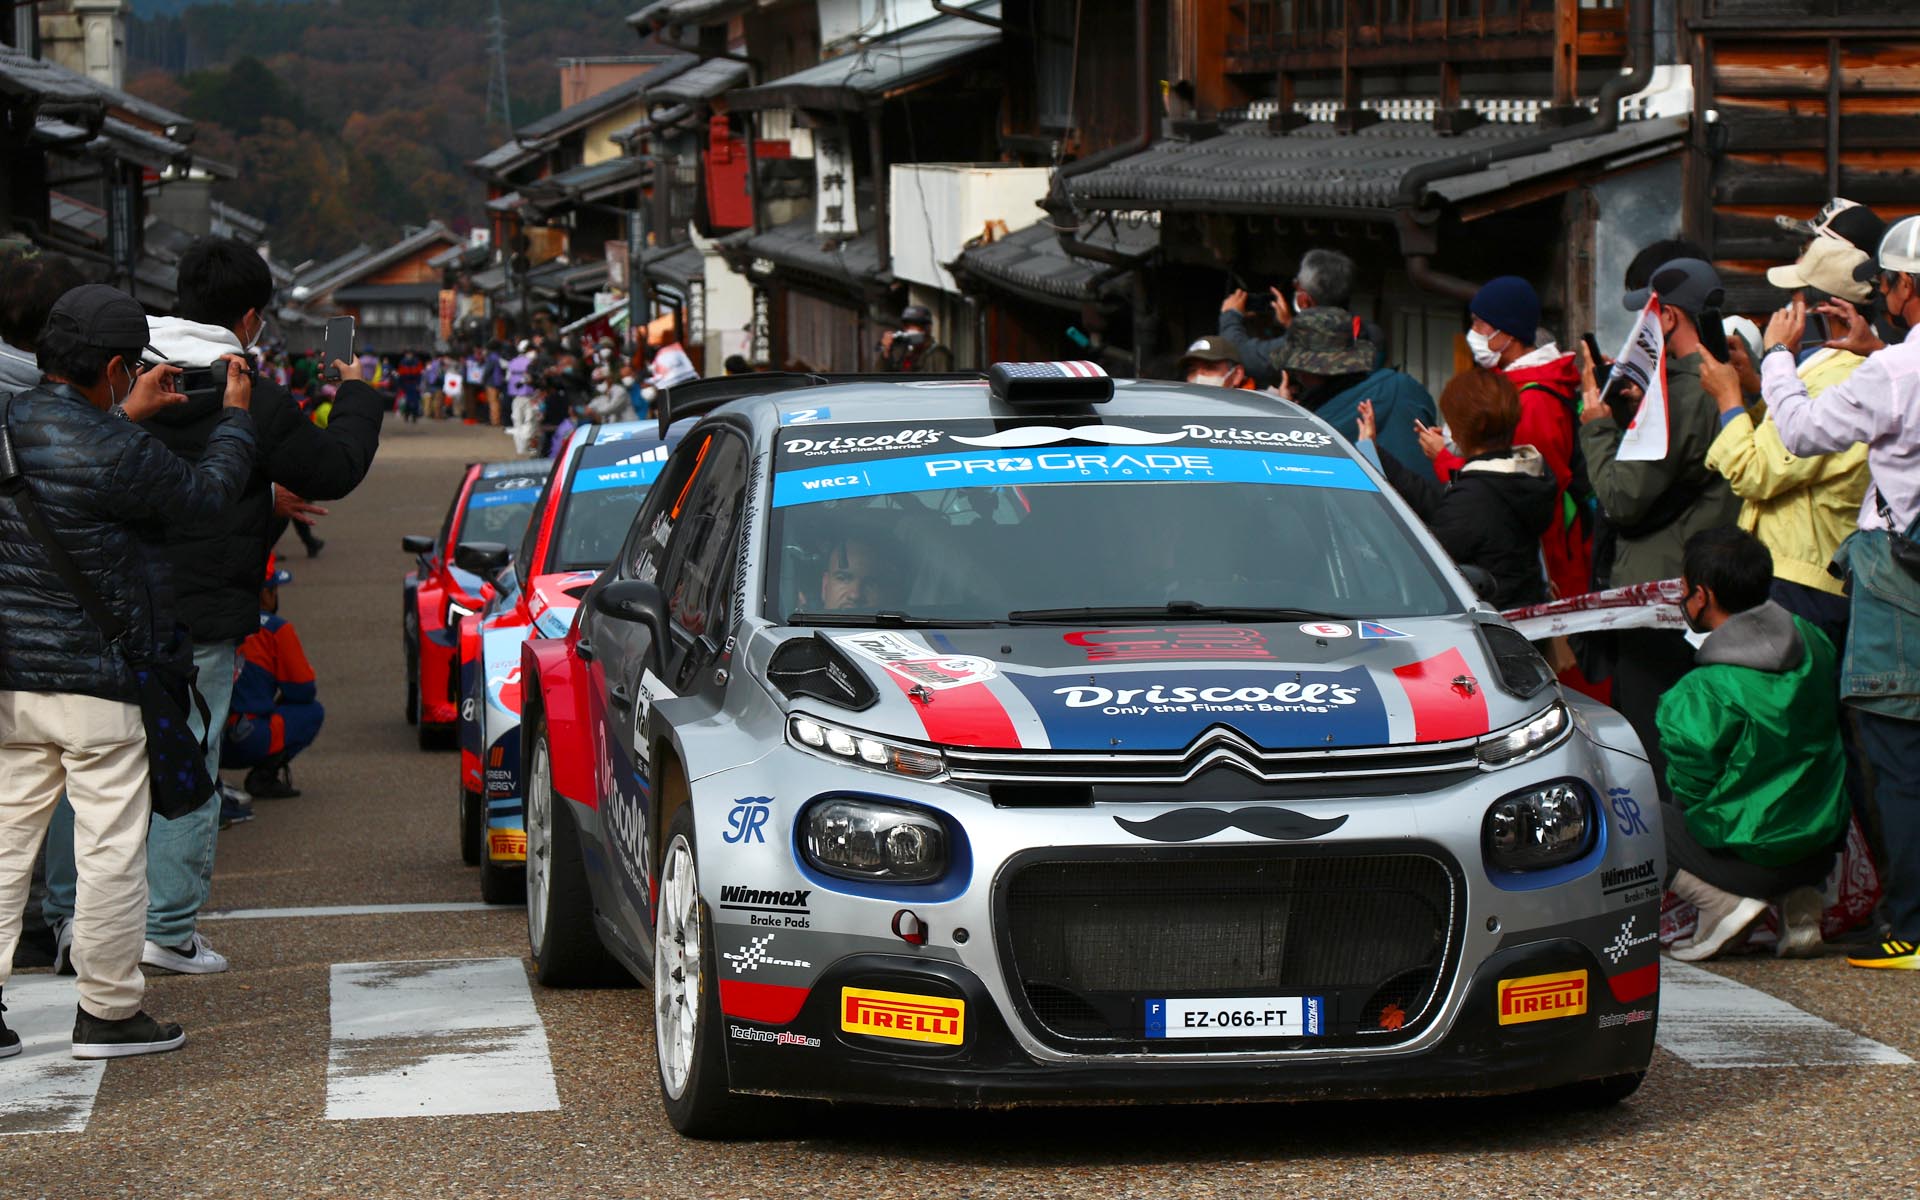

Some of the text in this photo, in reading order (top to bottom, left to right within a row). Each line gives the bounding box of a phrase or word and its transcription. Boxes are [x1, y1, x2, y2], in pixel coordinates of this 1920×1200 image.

[789, 409, 818, 423] 2
[783, 429, 944, 453] Driscoll's
[1182, 425, 1332, 445] Driscoll's
[598, 471, 638, 481] WRC2
[1081, 468, 1214, 476] DIGITAL
[802, 475, 860, 490] WRC2
[1313, 625, 1338, 634] E
[851, 640, 907, 661] Rally
[1102, 705, 1149, 715] Only
[1191, 703, 1254, 712] Finest
[491, 835, 526, 855] PIREL
[750, 915, 811, 929] Brake Pads
[1502, 978, 1585, 1016] PIRELLI
[846, 996, 960, 1035] PIRELLI
[1152, 1004, 1160, 1014] F
[1184, 1010, 1288, 1028] EZ-066-FT
[730, 1025, 821, 1048] Techno-plus.eu
